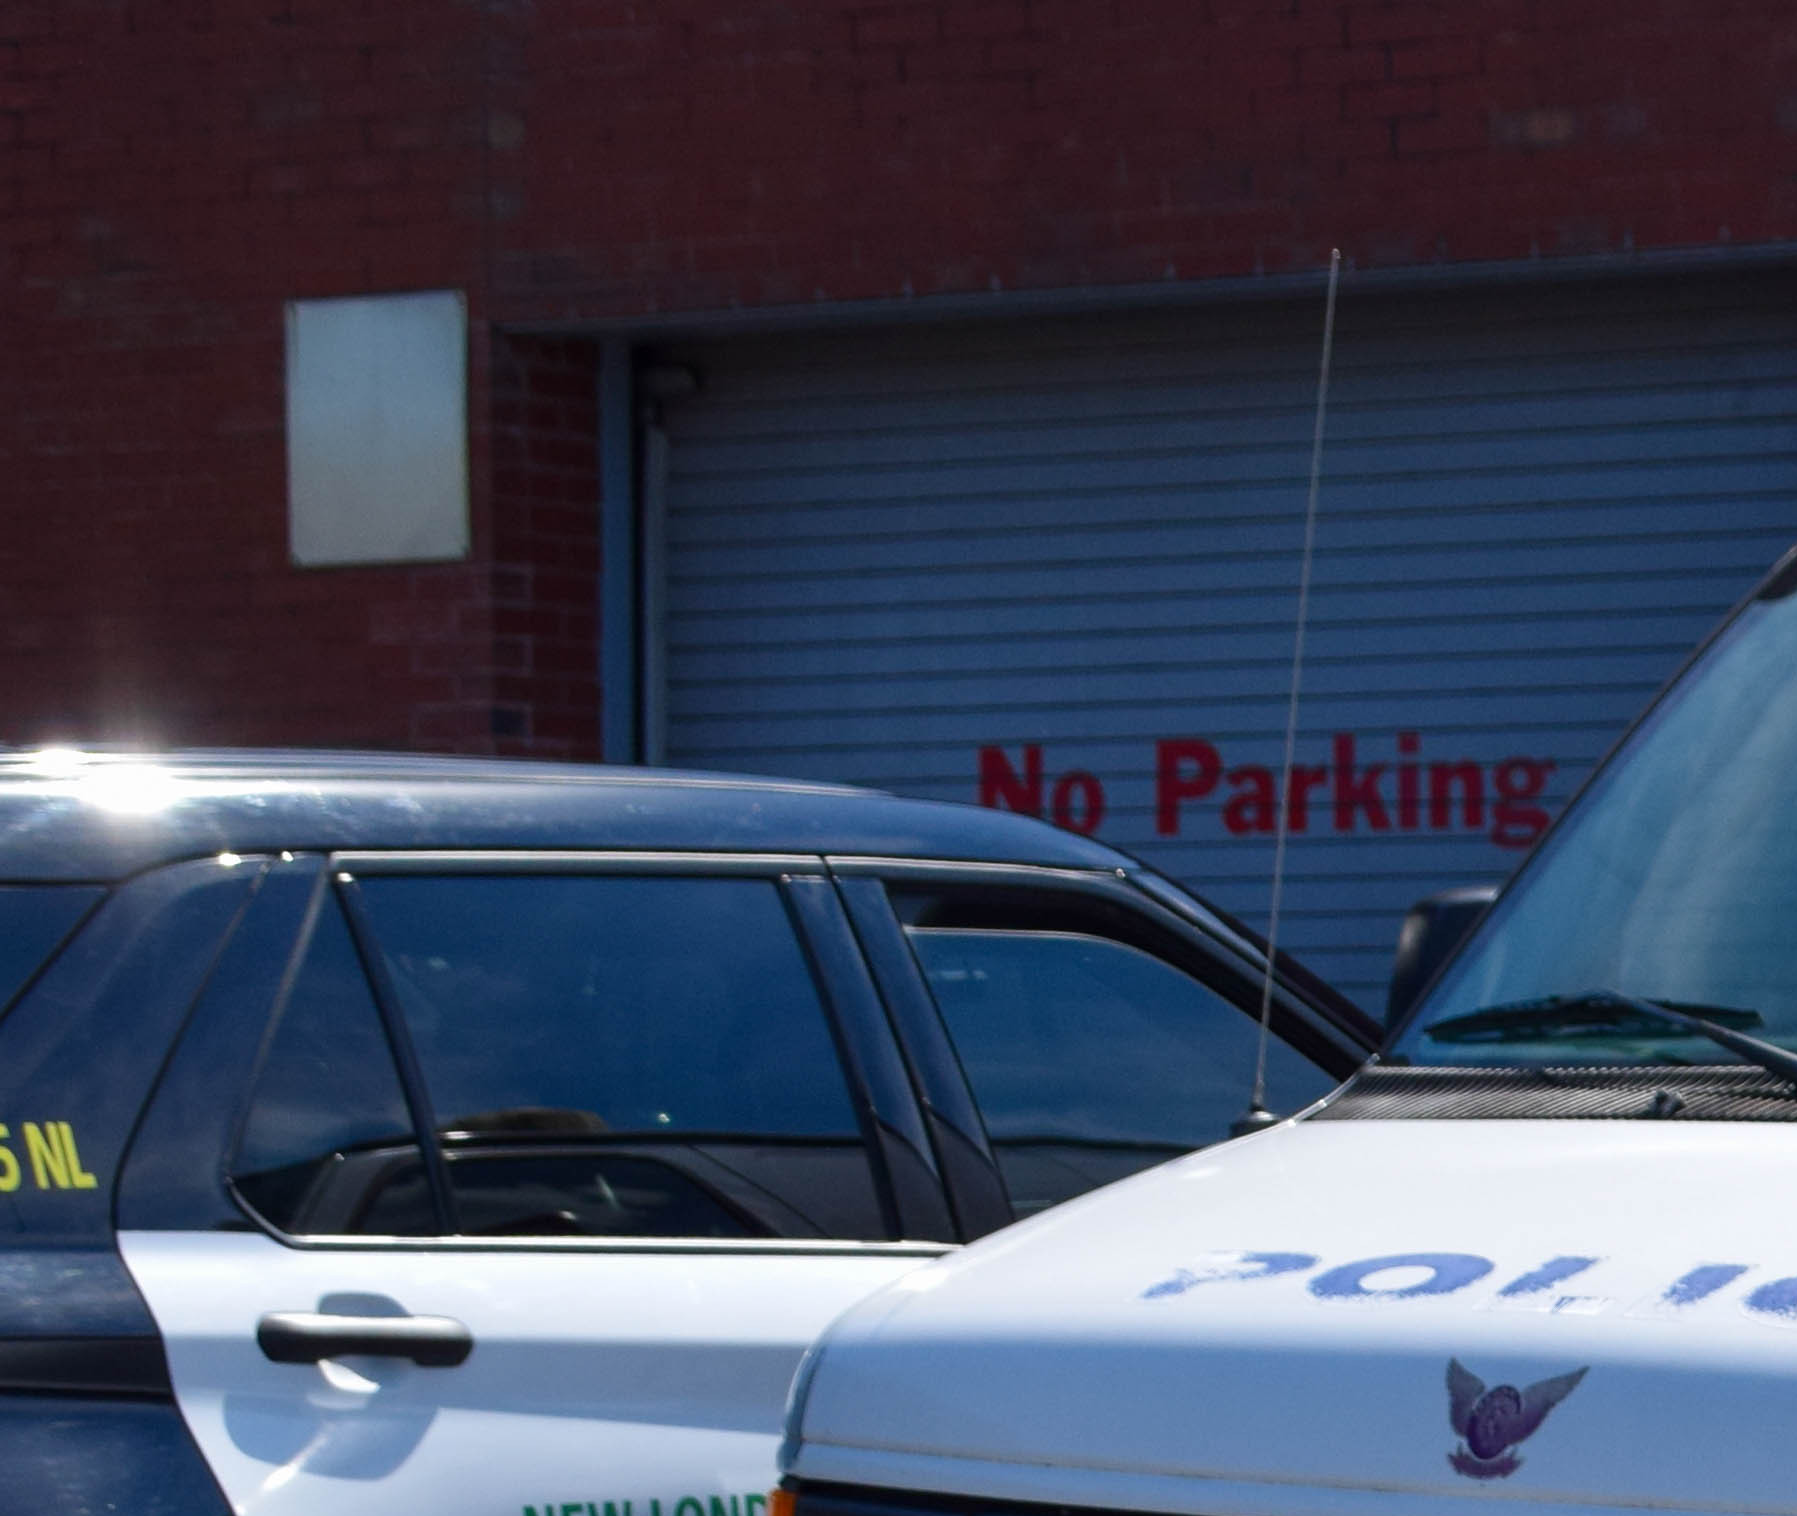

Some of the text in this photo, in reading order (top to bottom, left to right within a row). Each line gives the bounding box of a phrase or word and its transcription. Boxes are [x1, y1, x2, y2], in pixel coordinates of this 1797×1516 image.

[977, 731, 1557, 850] No Parking
[23, 1121, 98, 1188] NL
